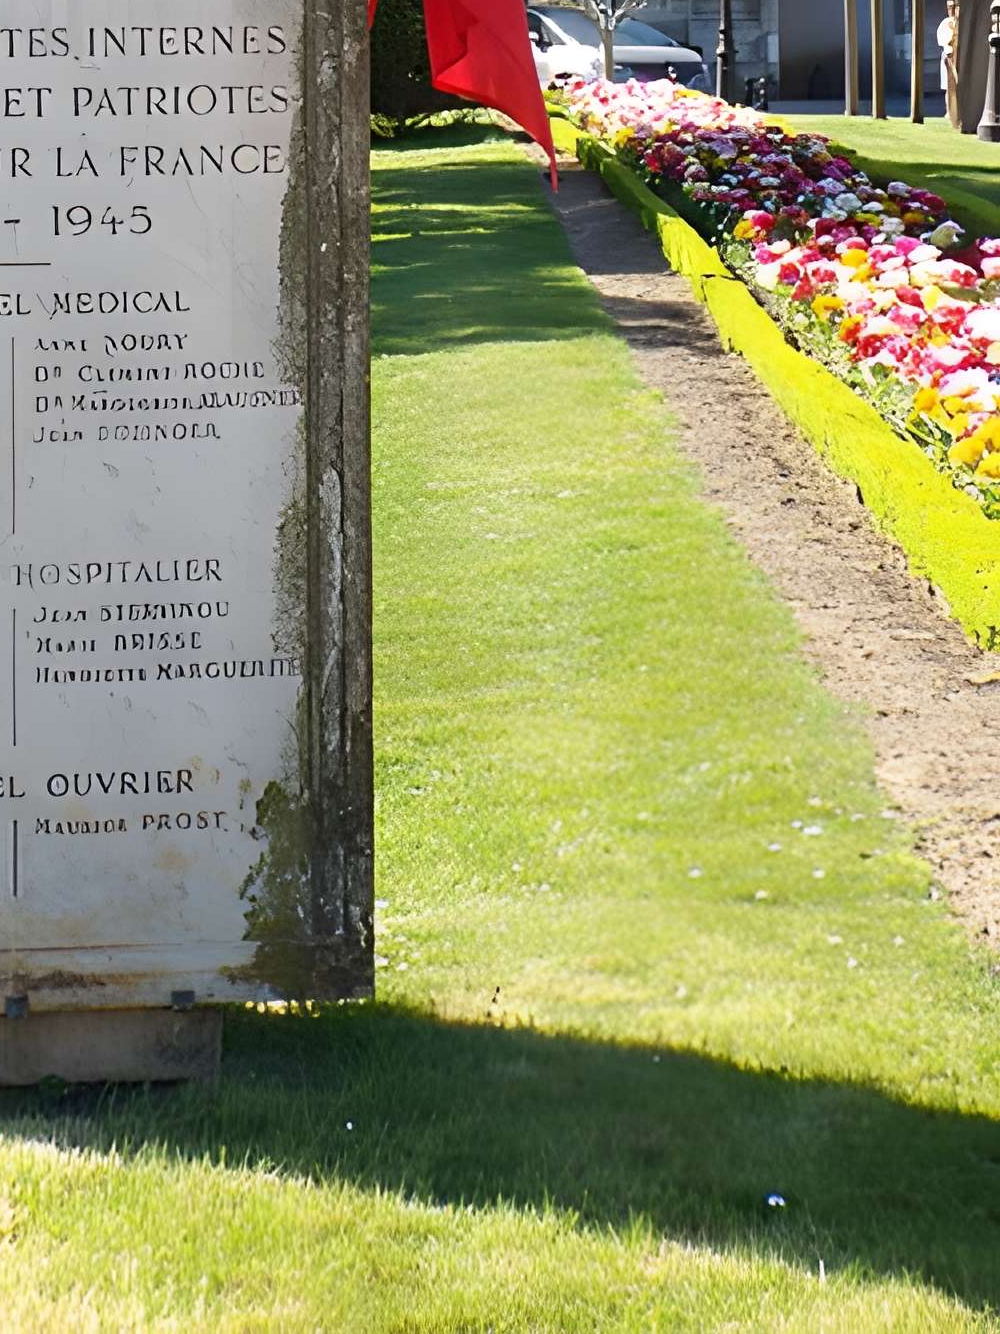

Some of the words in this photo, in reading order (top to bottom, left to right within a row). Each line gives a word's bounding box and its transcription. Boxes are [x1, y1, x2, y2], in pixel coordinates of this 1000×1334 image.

[87, 25, 289, 58] INTERNES
[3, 87, 53, 118] ET
[71, 83, 291, 118] PATRIOTES
[55, 146, 100, 178] LA
[119, 143, 287, 177] FRANCE
[50, 202, 153, 237] 1945
[51, 289, 191, 319] MEDICAL
[13, 558, 223, 588] HOSPITALIER
[46, 766, 197, 798] OUVRIER
